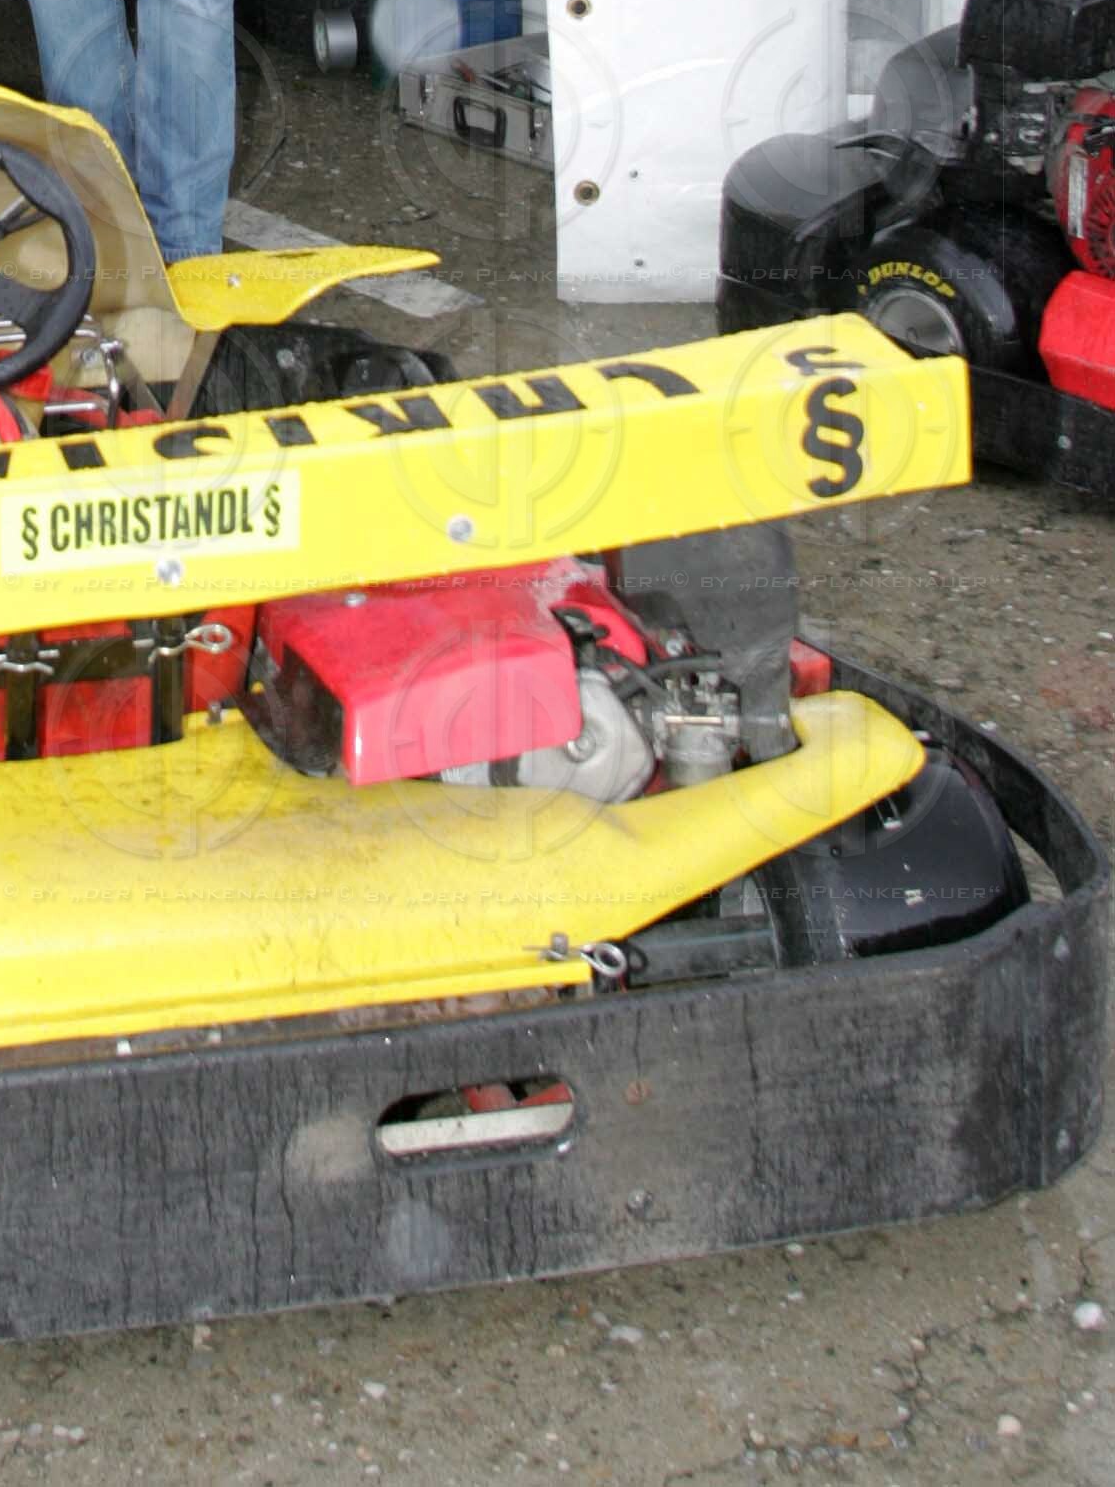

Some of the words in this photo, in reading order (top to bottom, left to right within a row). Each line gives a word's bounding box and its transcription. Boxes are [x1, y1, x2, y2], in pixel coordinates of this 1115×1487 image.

[867, 261, 955, 298] DUNLOP
[801, 376, 865, 499] §
[21, 507, 39, 560] §
[50, 486, 253, 552] CHRISTANDL
[264, 484, 281, 538] §
